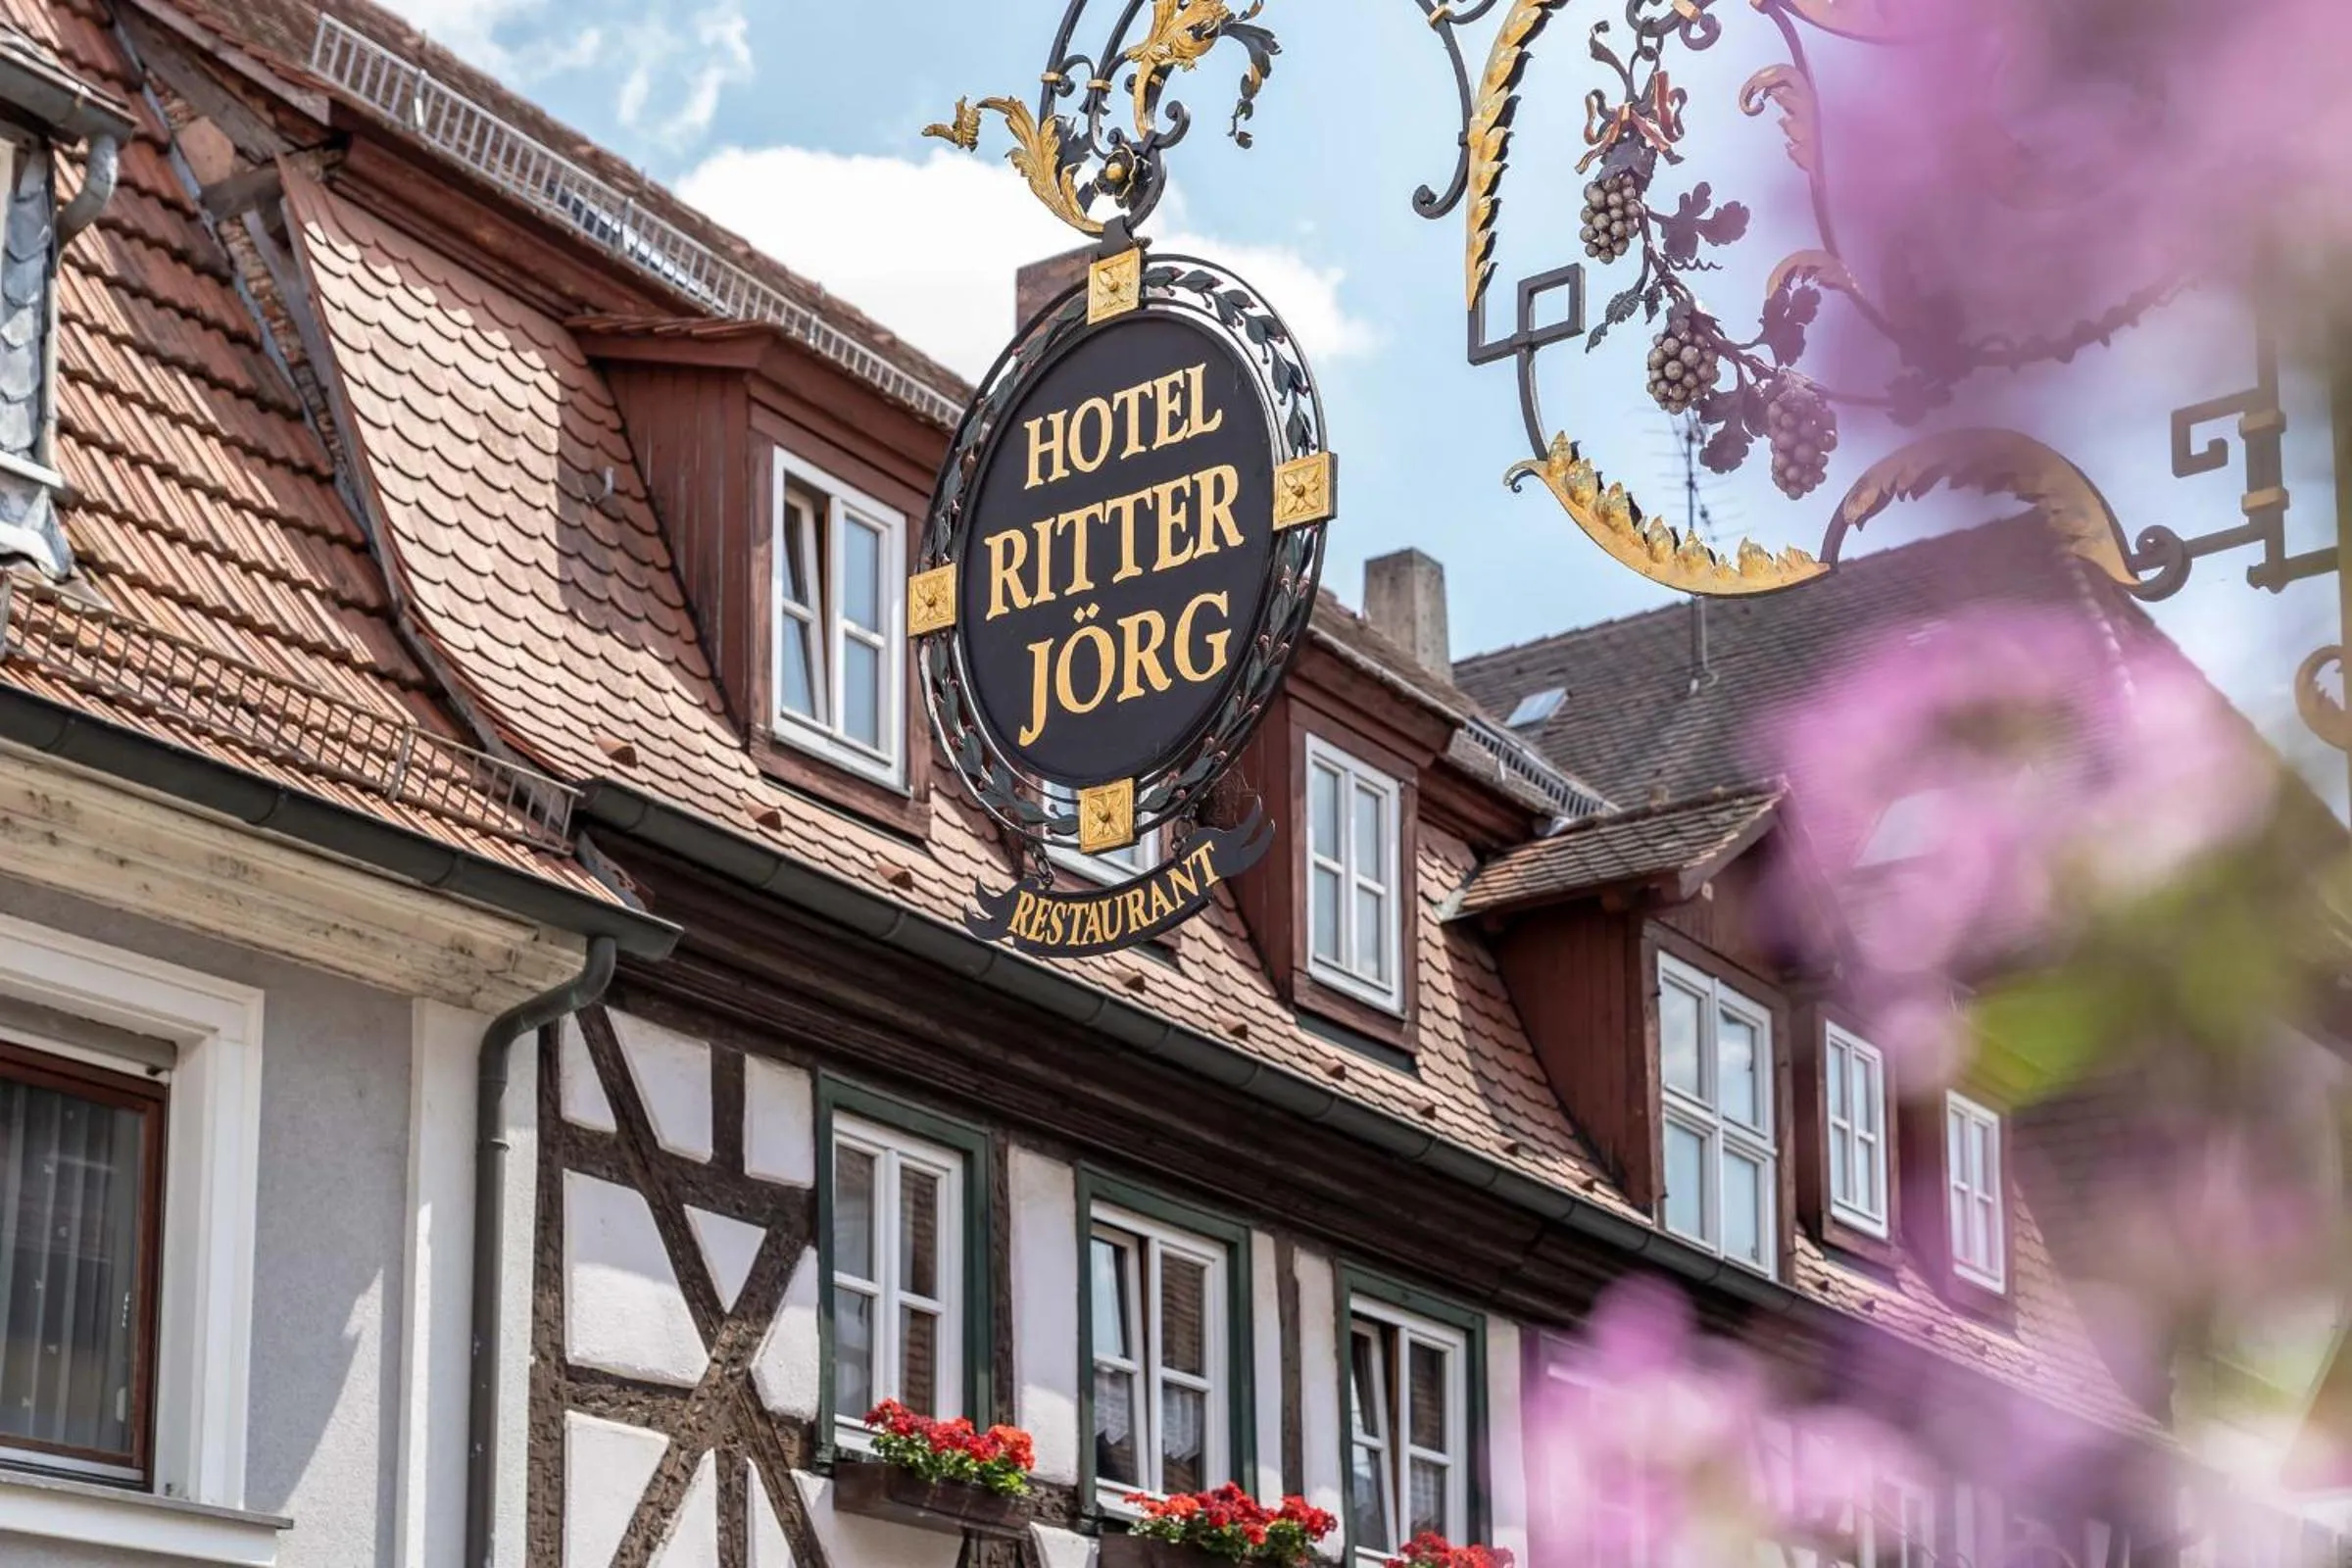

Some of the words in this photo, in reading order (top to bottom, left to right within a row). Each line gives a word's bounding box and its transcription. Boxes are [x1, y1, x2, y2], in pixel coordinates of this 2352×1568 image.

[1023, 362, 1223, 490] HOTEL
[984, 464, 1245, 621] RITTER
[1019, 590, 1232, 748] JÖRG
[1006, 840, 1221, 947] RESTAURANT
